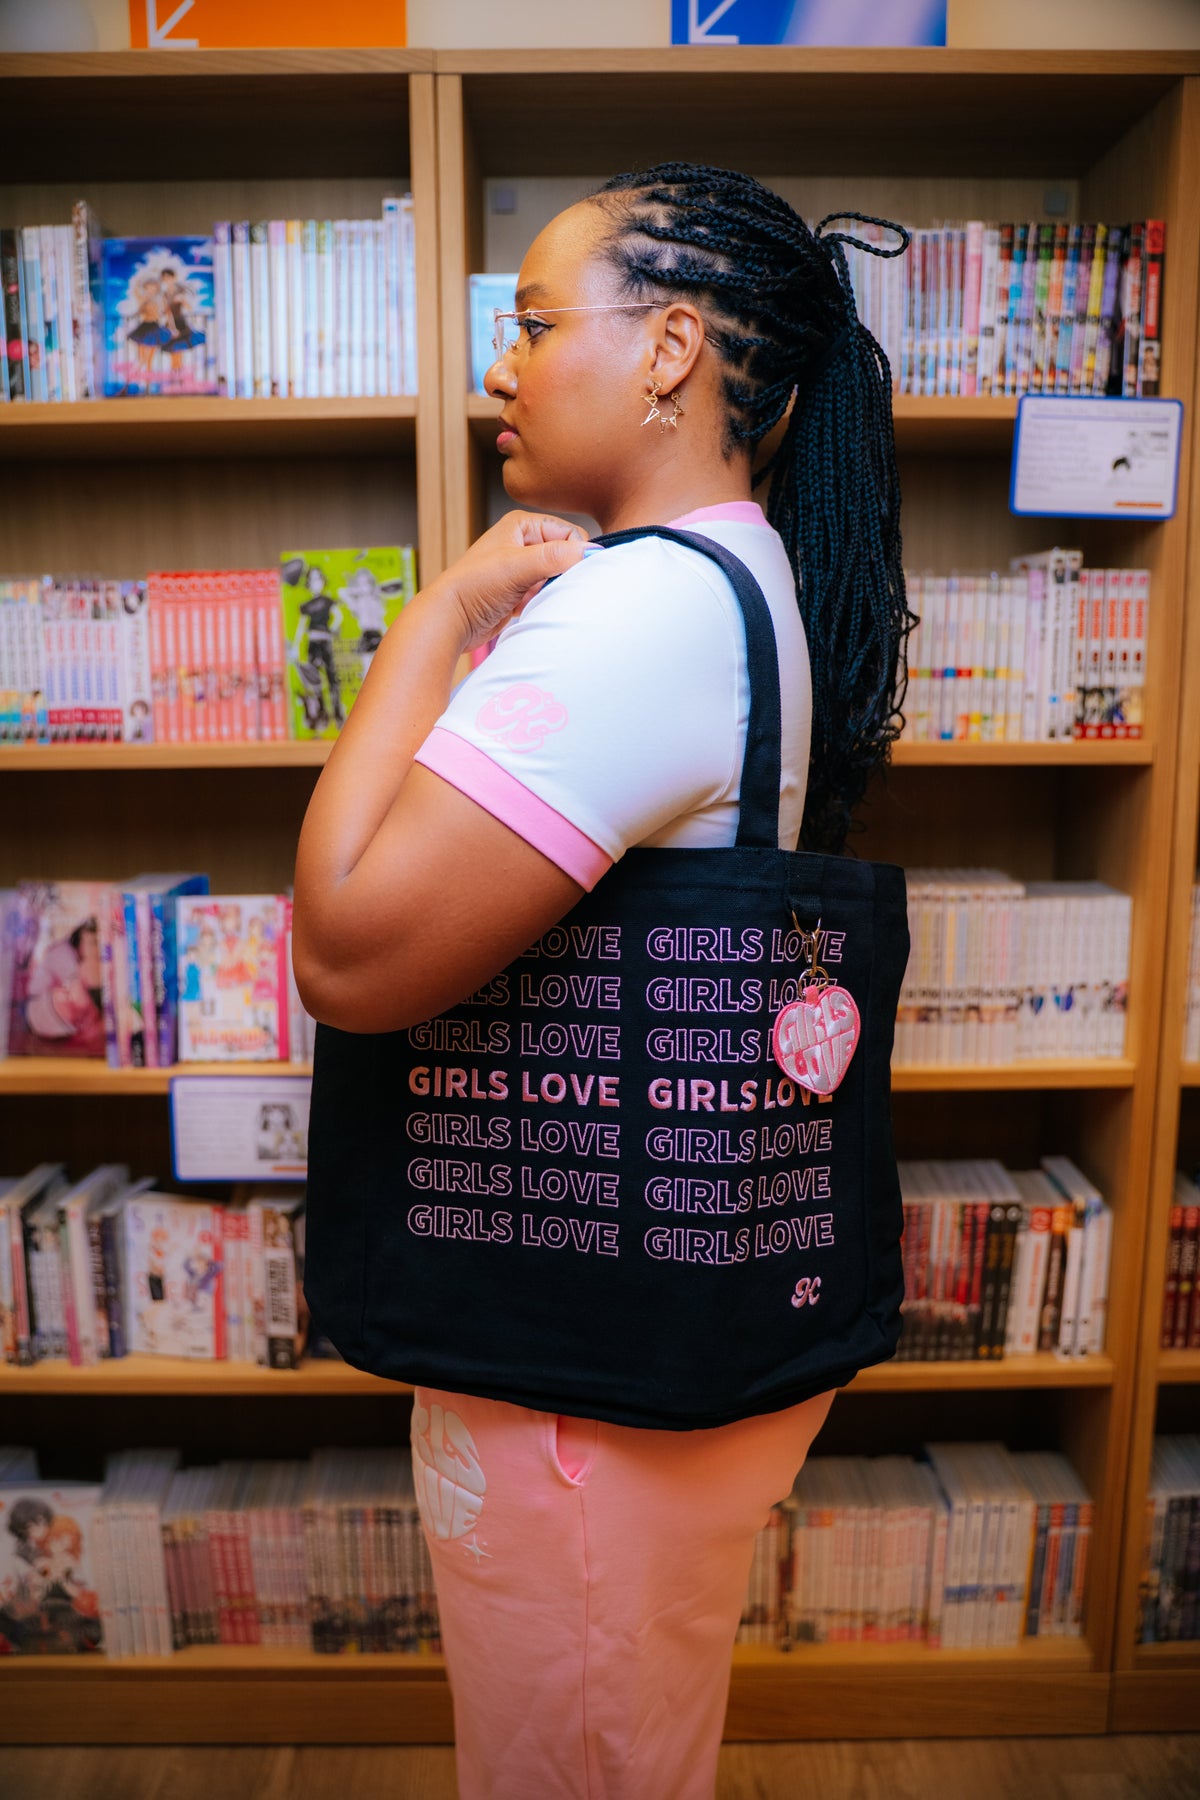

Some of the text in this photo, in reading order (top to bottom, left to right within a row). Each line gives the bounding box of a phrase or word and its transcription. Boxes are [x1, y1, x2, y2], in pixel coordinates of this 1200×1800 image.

[646, 926, 764, 963] GIRLS
[521, 974, 621, 1010] LOVE
[646, 977, 838, 1013] GIRLS LO
[408, 1019, 621, 1060] GIRLS LOVE
[779, 991, 854, 1053] GIRLS
[646, 1028, 761, 1064] GIRLS
[784, 1030, 855, 1092] LOVE
[408, 1066, 620, 1107] GIRLS LOVE
[647, 1077, 758, 1112] GIRLS
[406, 1112, 620, 1159] GIRLS LOVE
[645, 1119, 832, 1164] GIRLS LOVE
[407, 1158, 620, 1208] GIRLS LOVE
[645, 1166, 831, 1214] GIRLS LOVE
[407, 1205, 620, 1257] GIRLS LOVE
[643, 1213, 835, 1265] GIRLS LOVE
